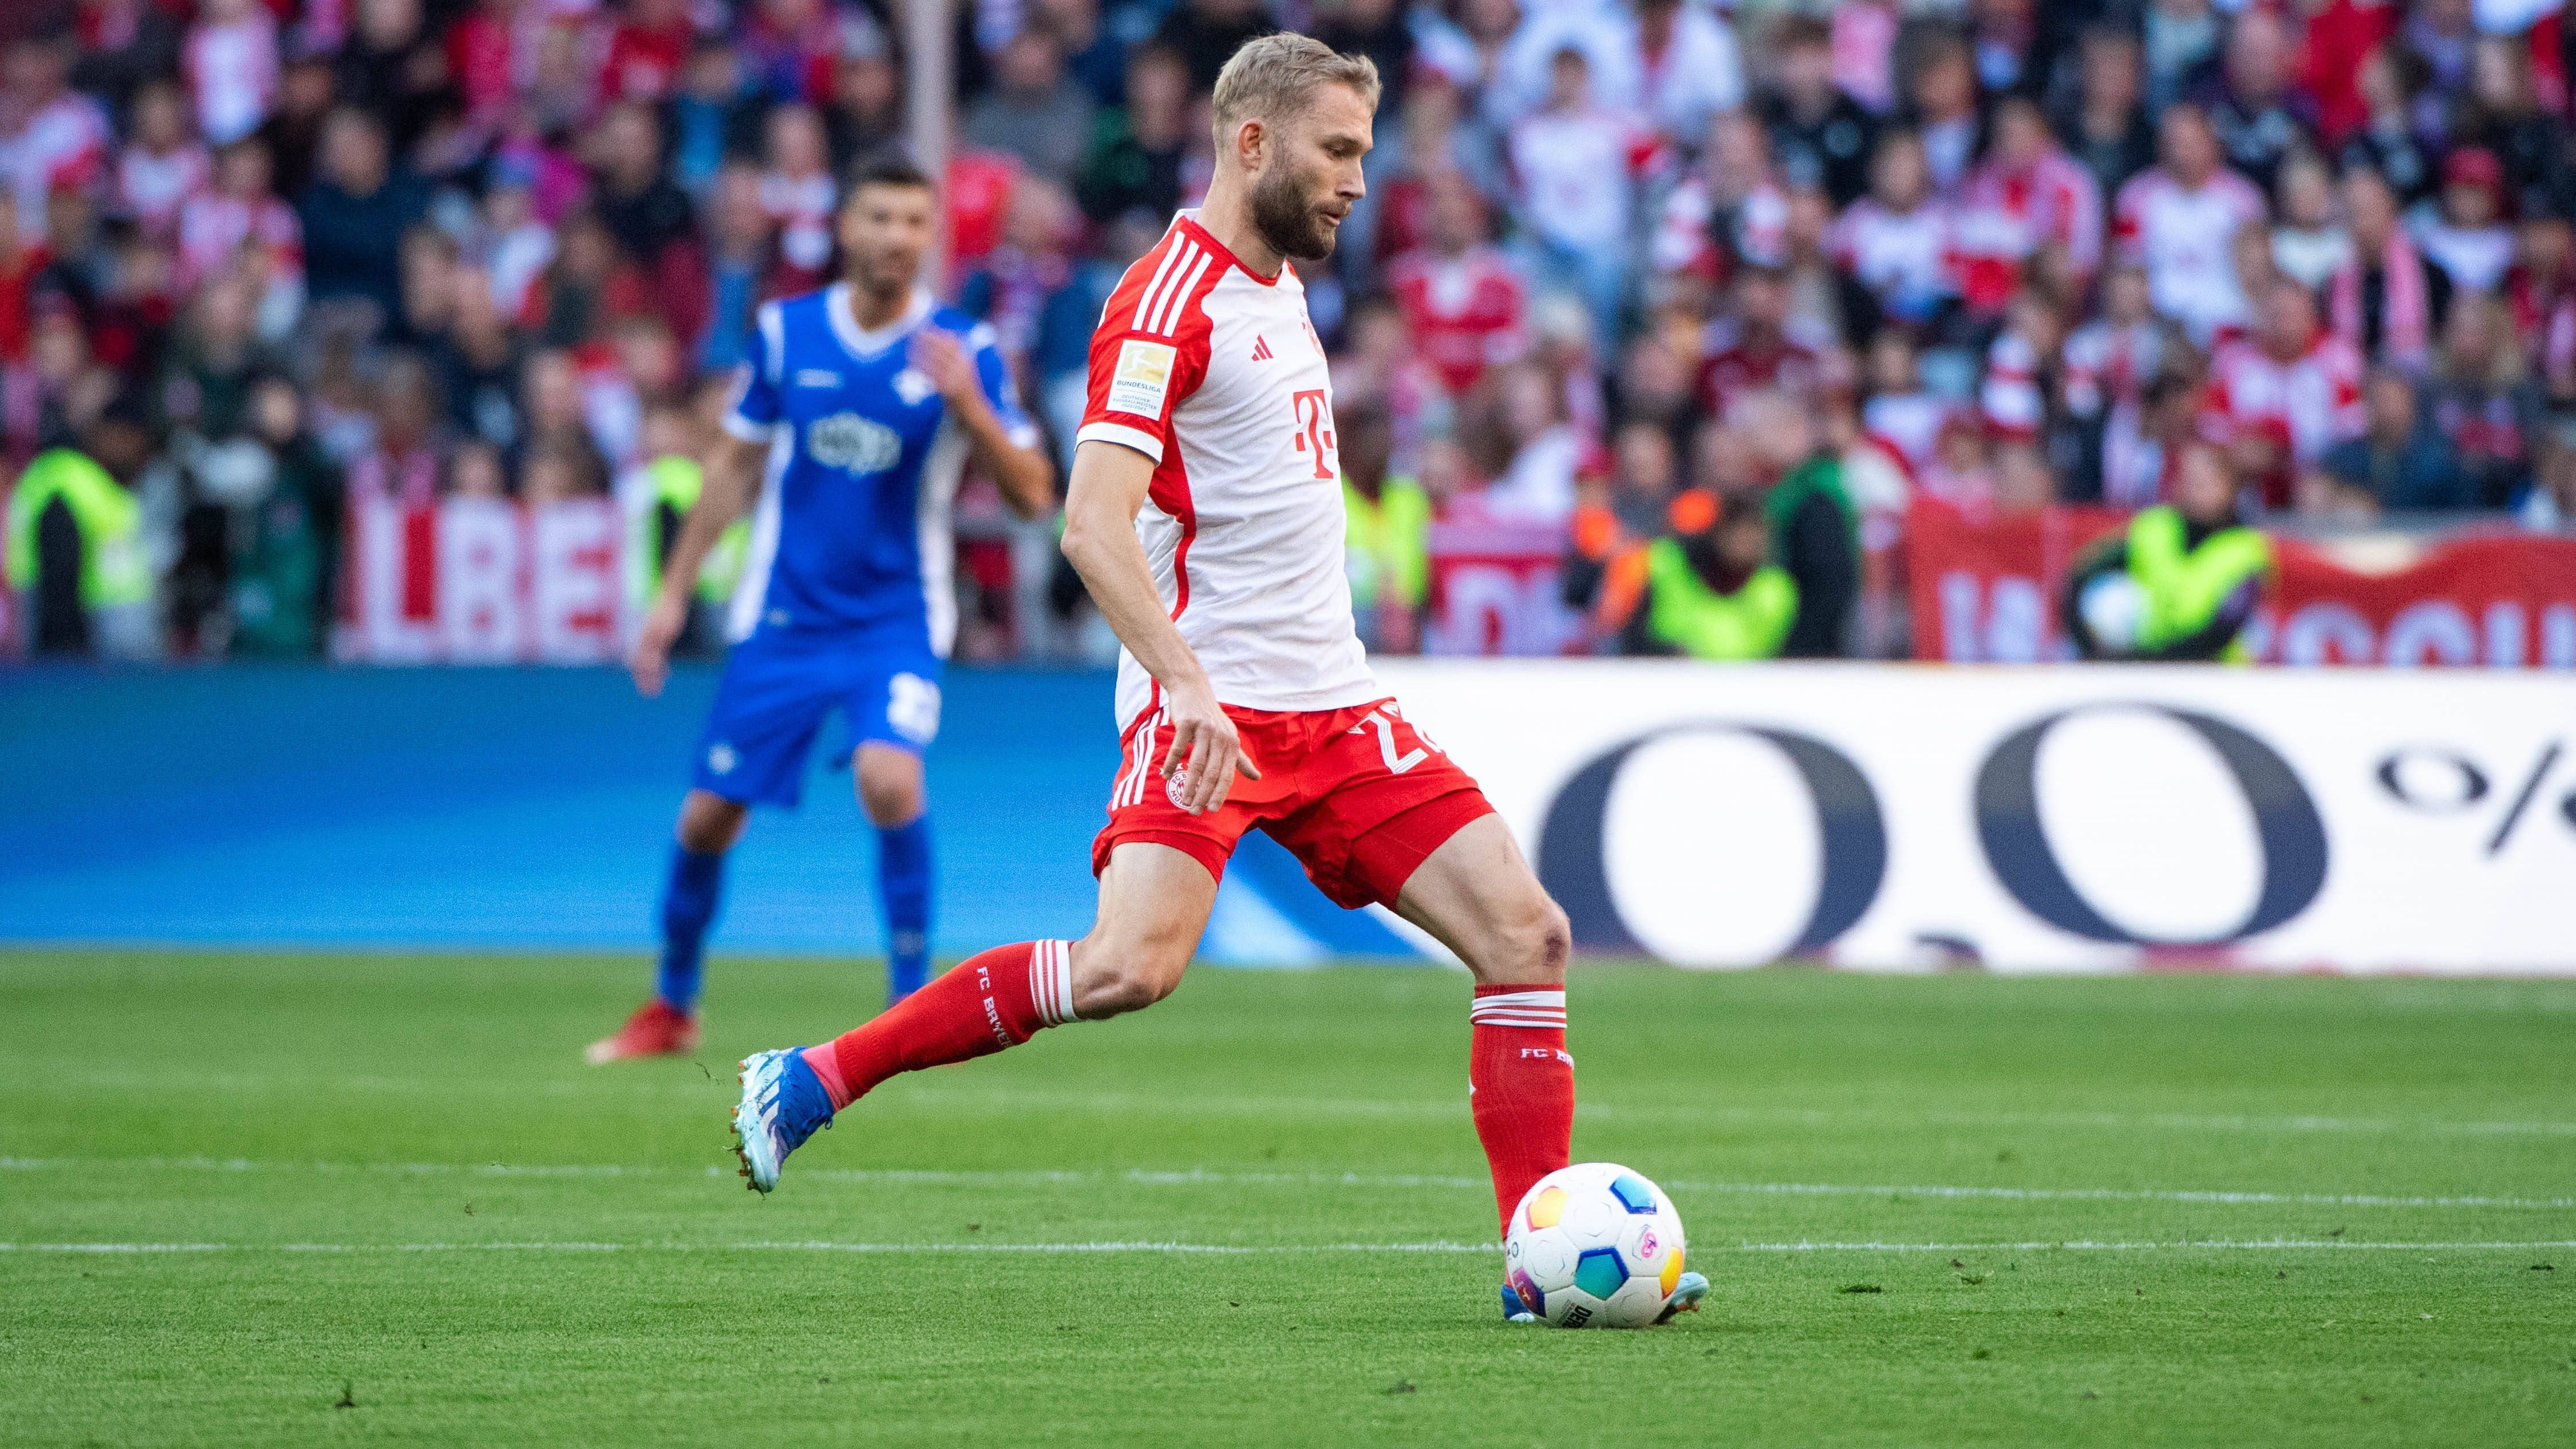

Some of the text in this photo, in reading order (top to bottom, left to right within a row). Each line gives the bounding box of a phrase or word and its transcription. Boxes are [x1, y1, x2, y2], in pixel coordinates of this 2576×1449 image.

[1117, 380, 1161, 393] BUNDESLIGA
[1293, 389, 1334, 479] T
[977, 966, 990, 990] FC
[1520, 1048, 1548, 1059] FC
